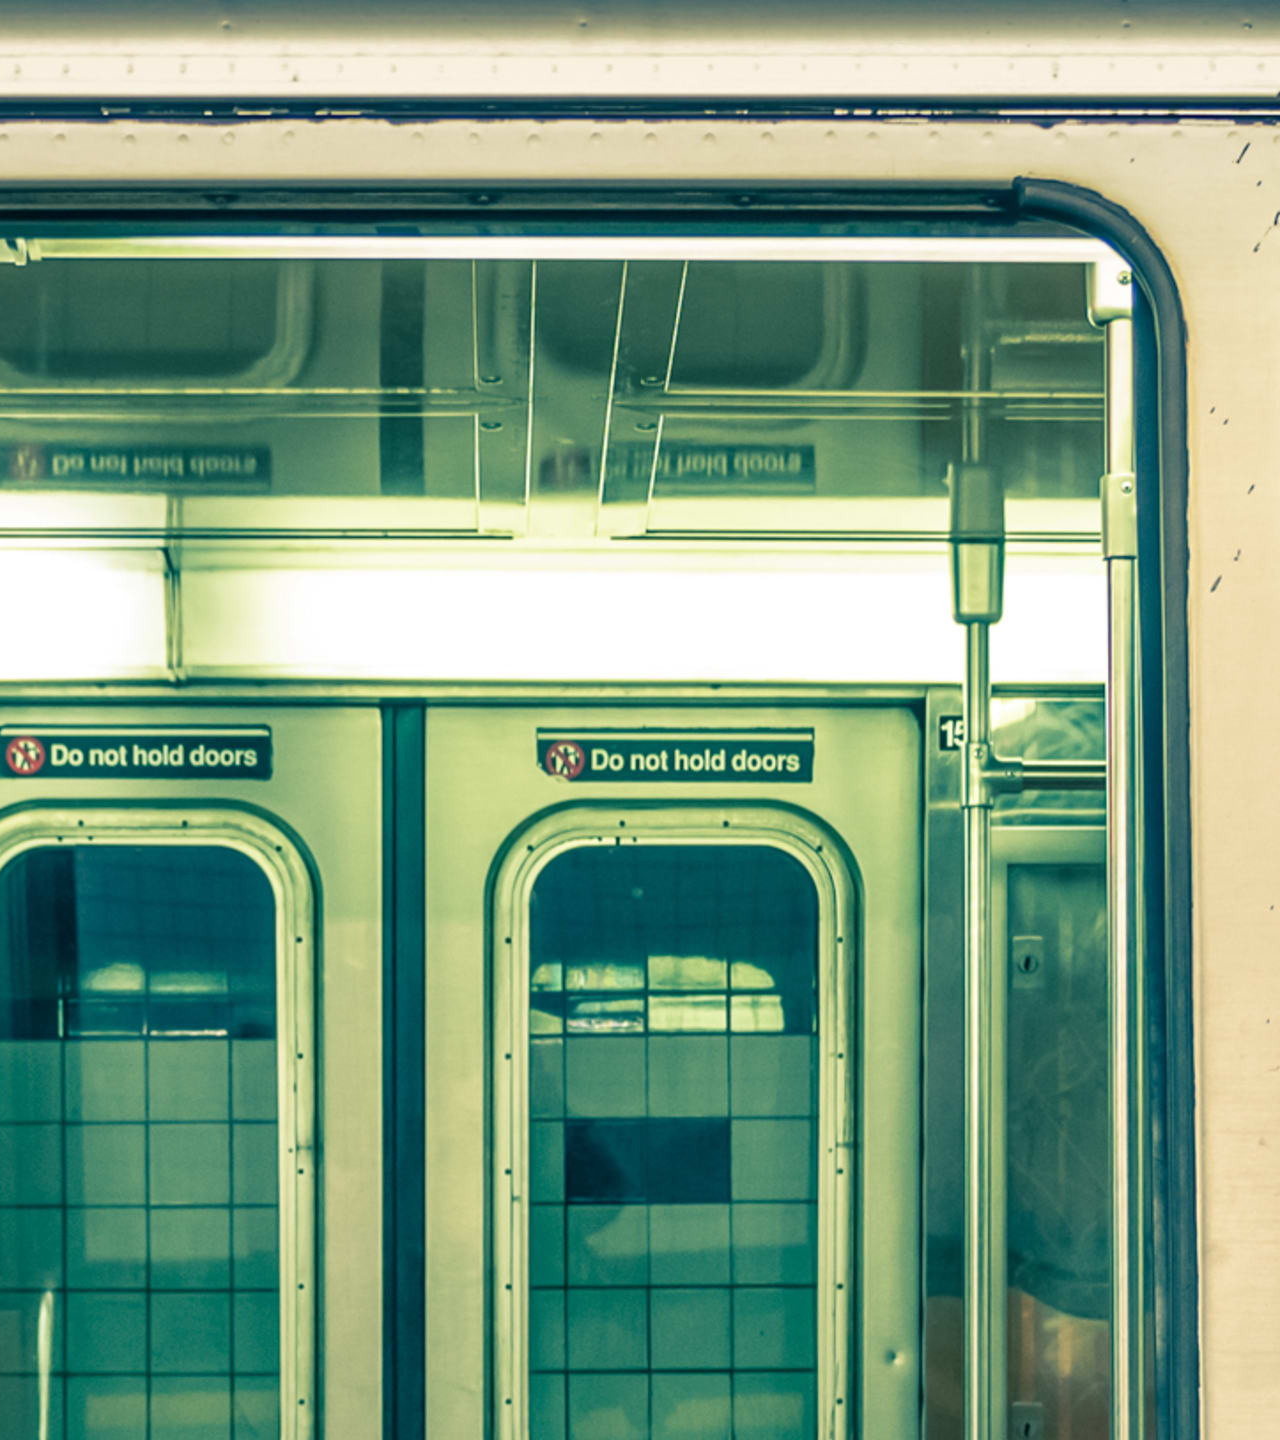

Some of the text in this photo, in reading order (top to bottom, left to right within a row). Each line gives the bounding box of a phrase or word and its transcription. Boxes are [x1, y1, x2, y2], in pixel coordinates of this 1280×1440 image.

[51, 744, 257, 767] Do not hold doors
[592, 749, 799, 772] Do not hold doors
